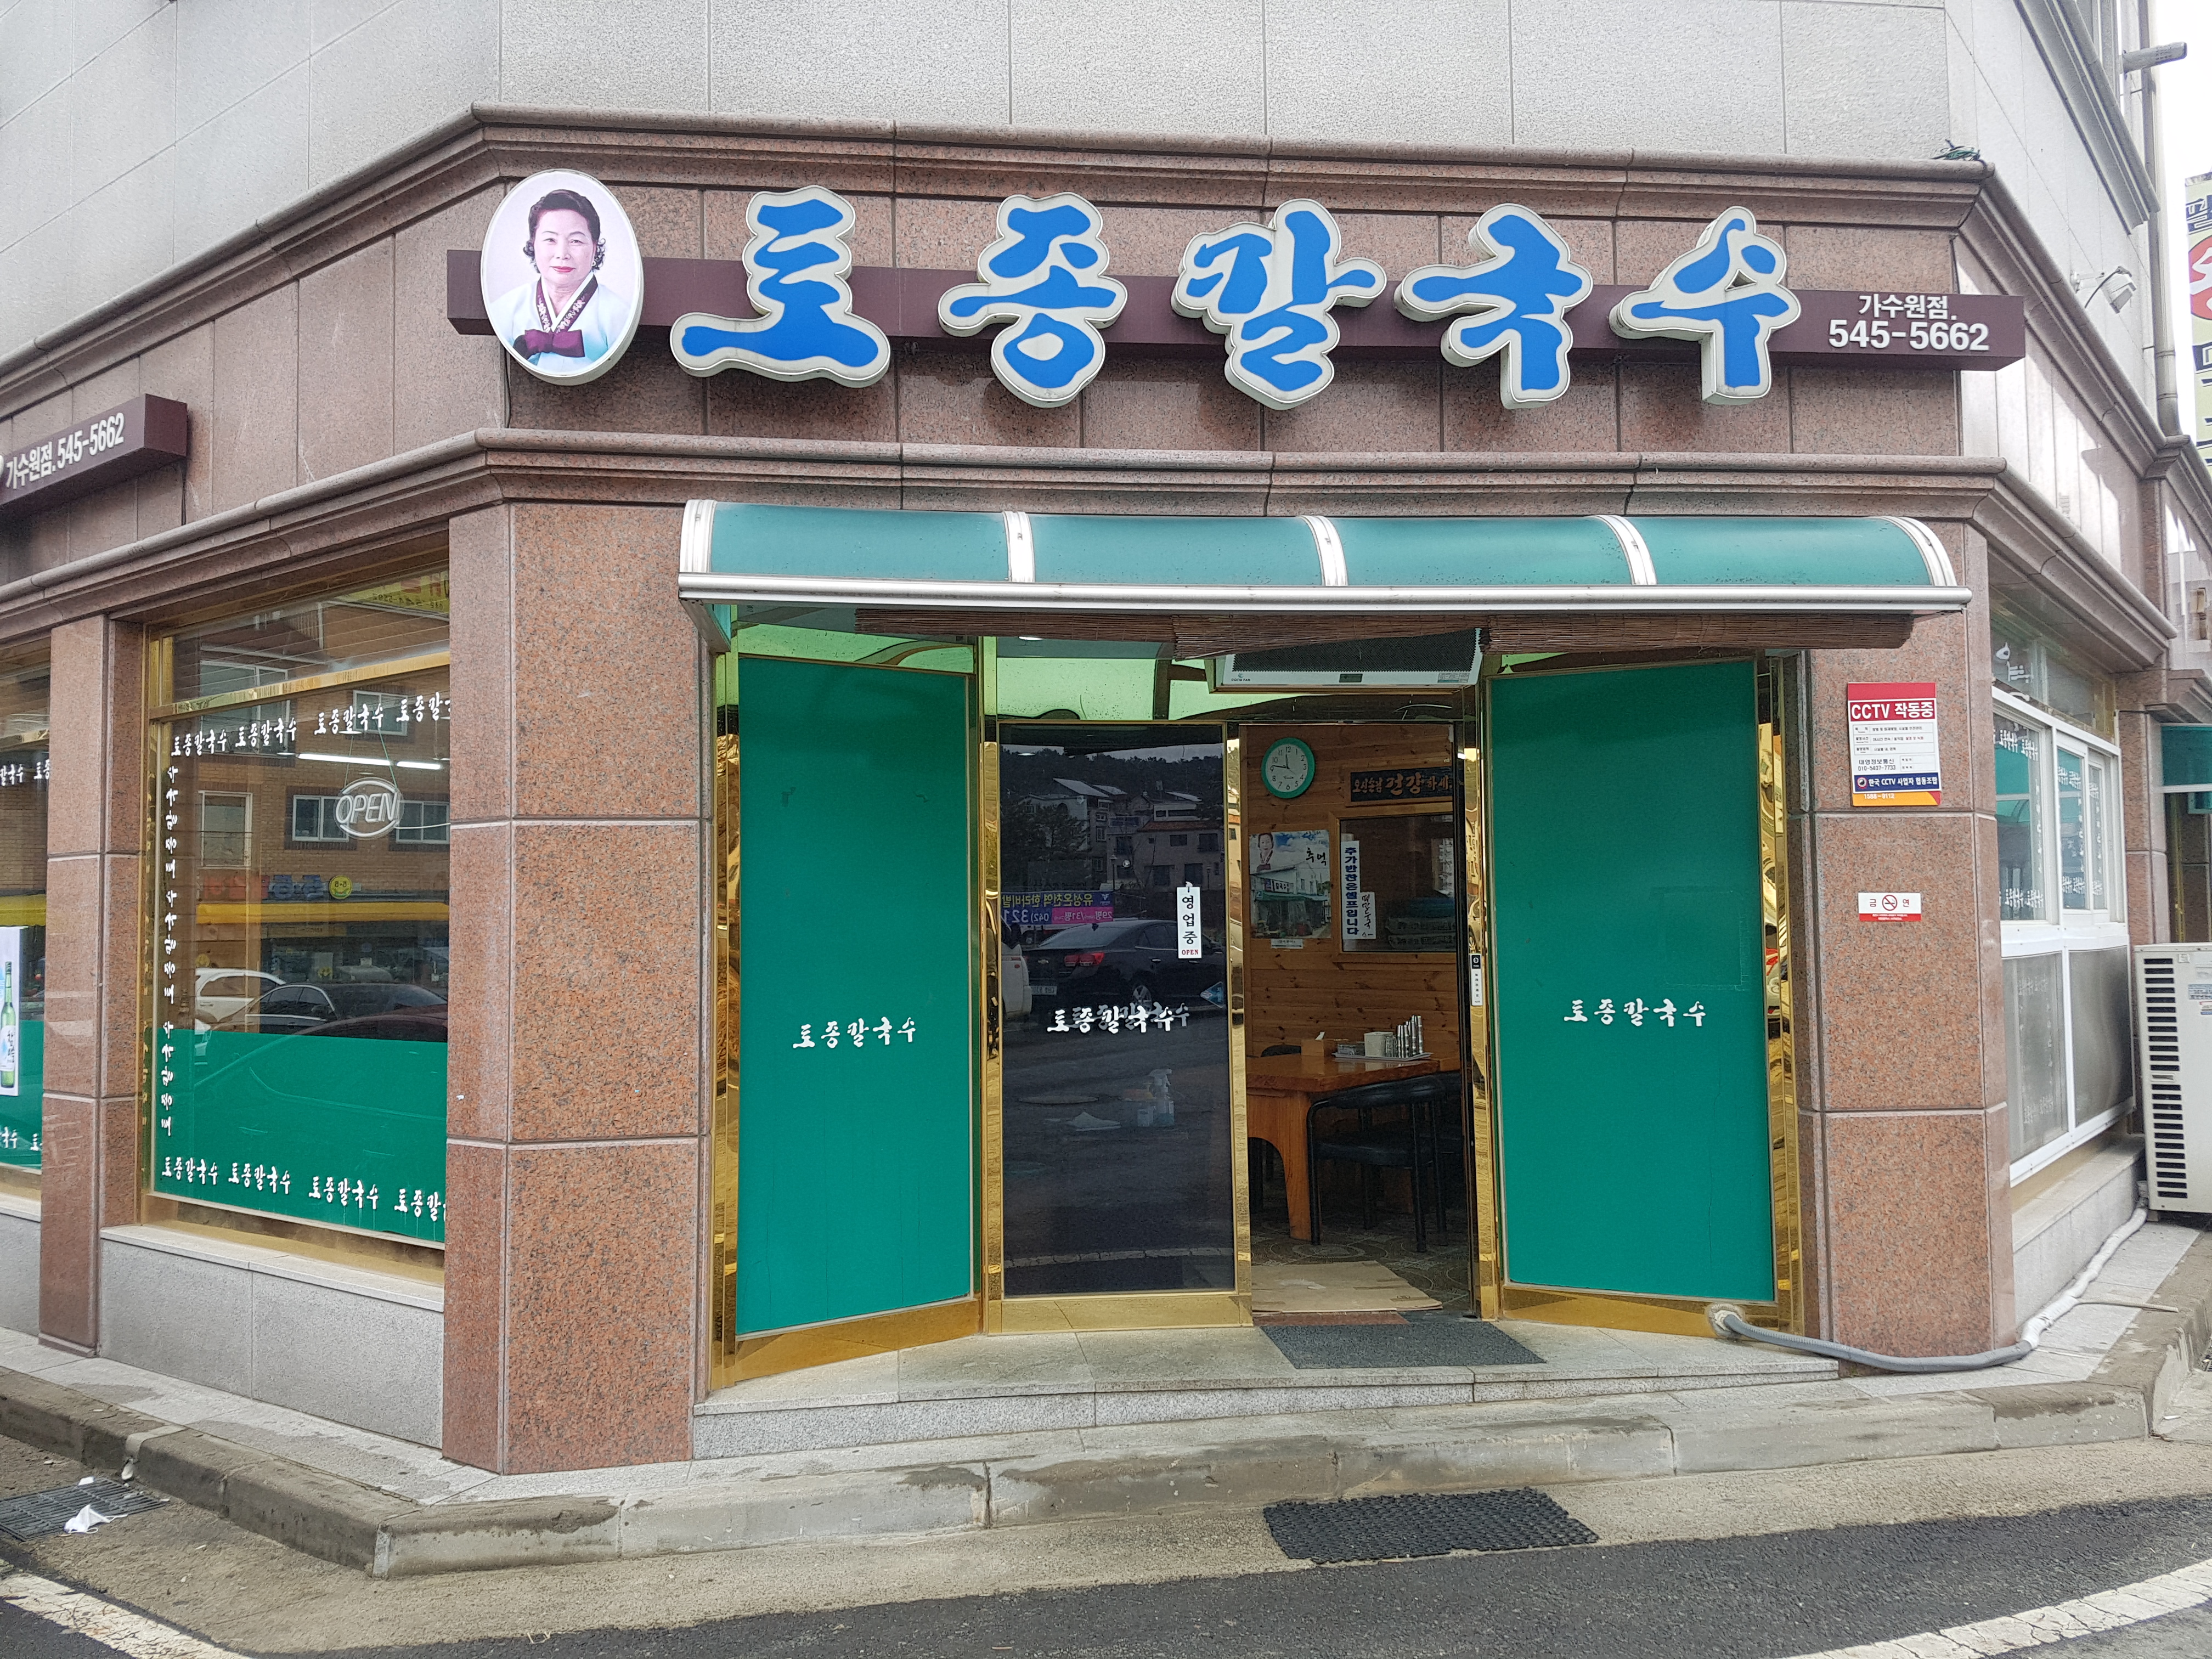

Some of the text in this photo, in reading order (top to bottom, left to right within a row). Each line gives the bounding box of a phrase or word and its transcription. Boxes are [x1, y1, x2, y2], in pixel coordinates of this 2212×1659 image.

[669, 184, 1802, 409] 토종칼국수
[1829, 319, 1990, 351] 545-5662
[57, 413, 125, 469] 545-5662
[1851, 702, 1933, 719] CCTV 작동중
[171, 729, 228, 757] 토종칼국수
[235, 718, 297, 747] 토종칼국수
[314, 703, 383, 735] 토종칼국수
[1385, 772, 1453, 795] 건강하세
[1869, 778, 1880, 787] 한국
[1898, 777, 1914, 786] 사업자
[1916, 776, 1938, 785] 협동조합
[335, 792, 398, 825] OPEN
[1306, 847, 1327, 866] 추억
[1182, 895, 1198, 945] 영업중
[1047, 1005, 1174, 1034] 토종칼국수
[1564, 998, 1706, 1027] 토종칼국수
[793, 1016, 916, 1048] 토종칼국수
[162, 1156, 446, 1222] 토종칼국수 토종칼국수 토종칼국수 토종칼
